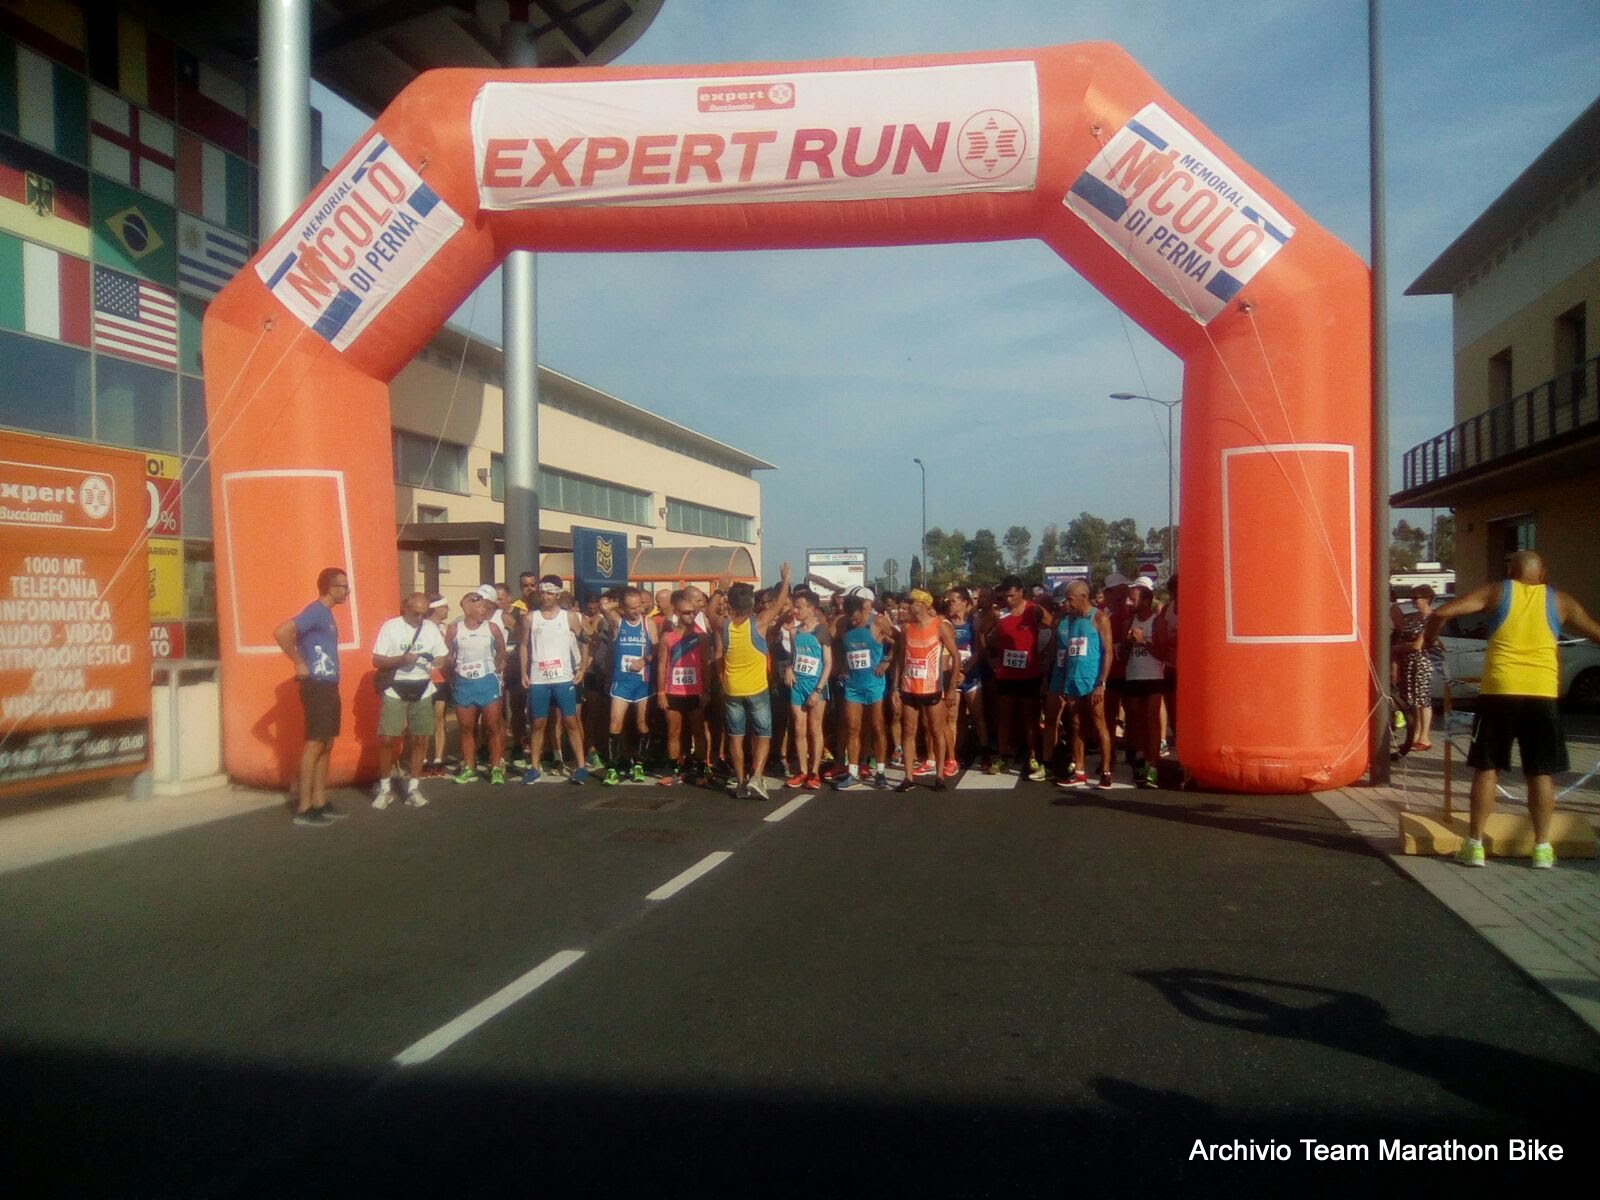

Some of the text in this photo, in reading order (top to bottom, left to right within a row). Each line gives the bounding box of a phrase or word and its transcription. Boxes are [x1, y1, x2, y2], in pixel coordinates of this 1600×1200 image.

[700, 91, 766, 102] expert
[482, 121, 951, 188] EXPERT RUN
[1179, 154, 1245, 208] MEMORIAL
[302, 181, 353, 242] MEMORIAL
[349, 211, 420, 293] DI PERNA
[1124, 209, 1212, 283] DI PERNA
[0, 483, 75, 503] xpert
[24, 557, 60, 574] 1000
[10, 576, 98, 598] TELEFONIA
[65, 623, 113, 643] VIDEO
[797, 663, 814, 673] 187
[851, 660, 867, 668] 178
[466, 671, 479, 679] 96
[676, 676, 694, 685] 165
